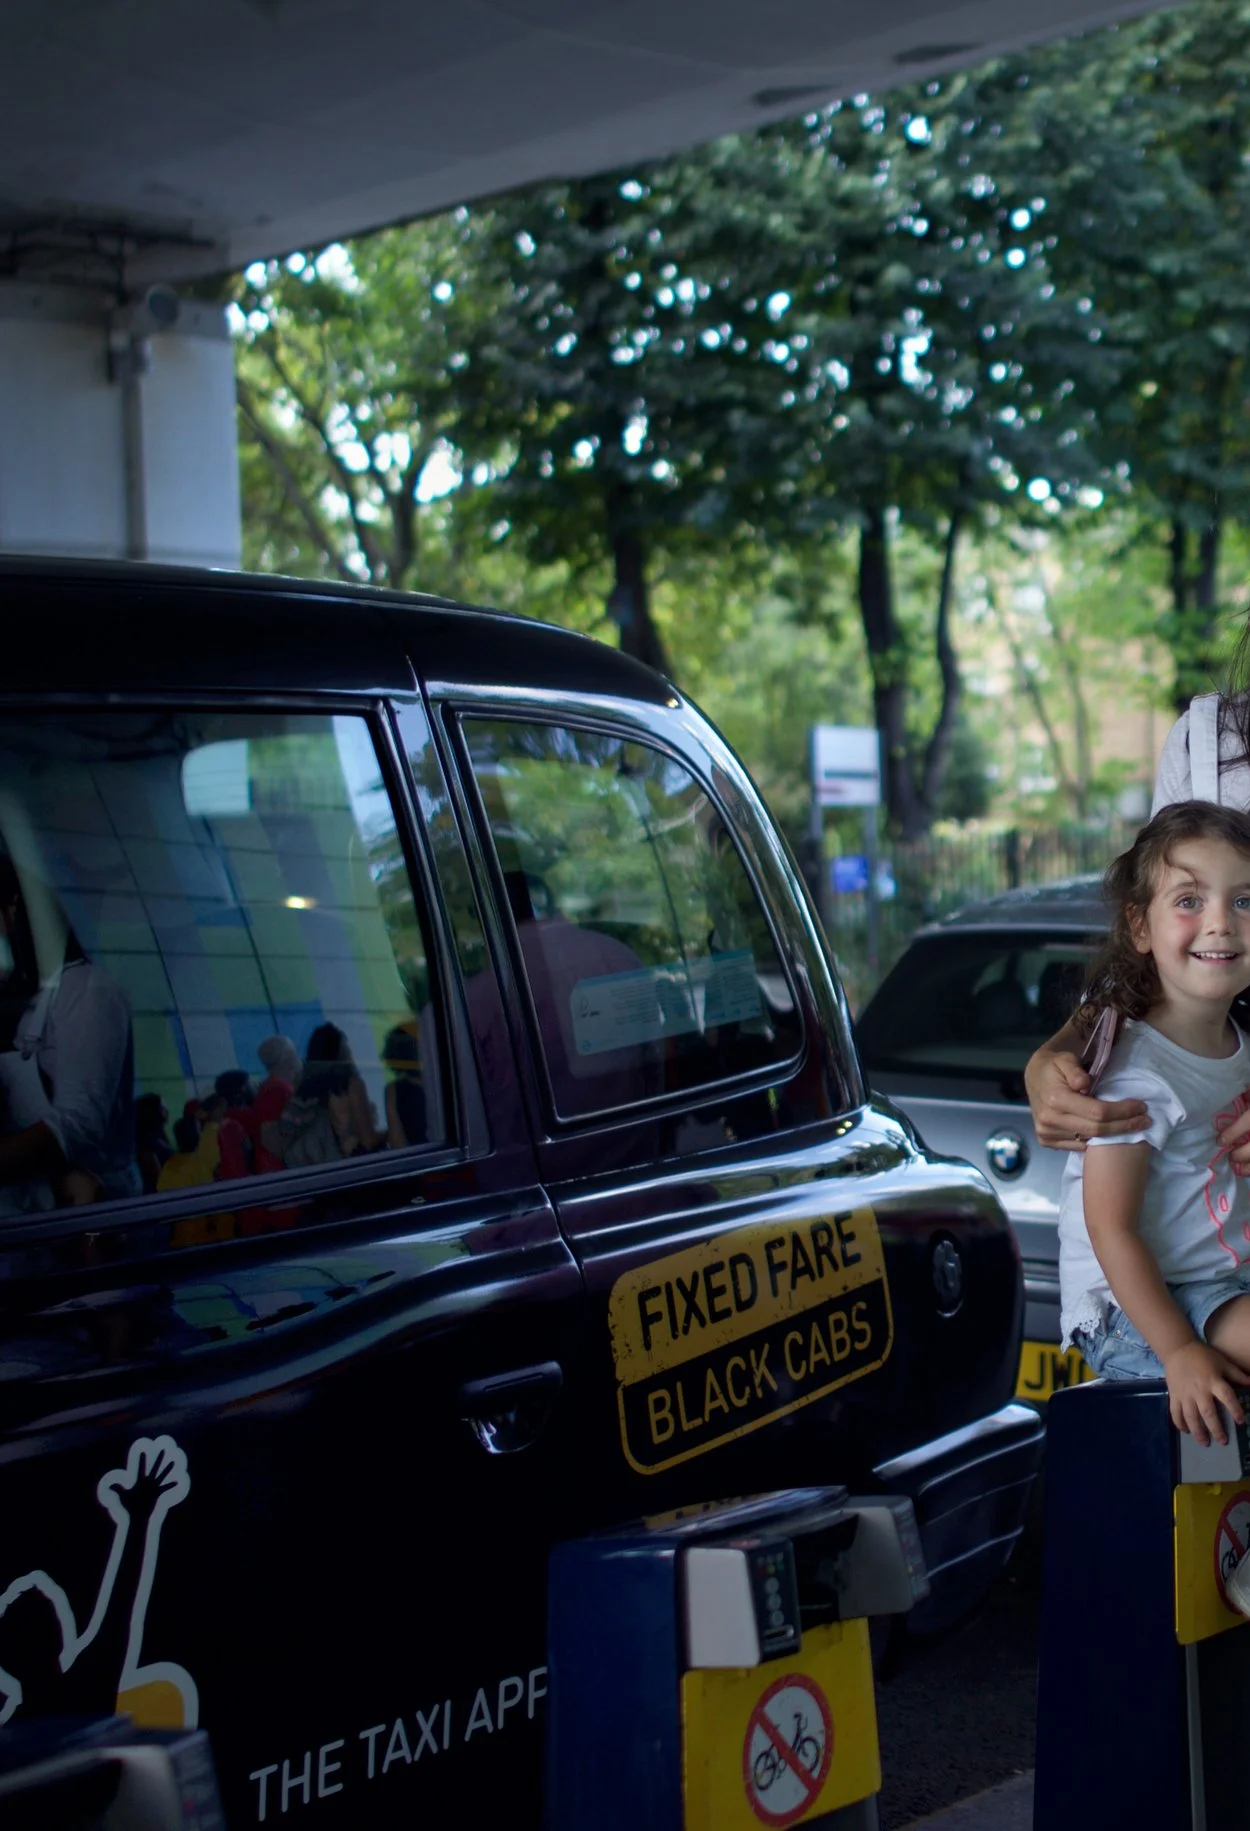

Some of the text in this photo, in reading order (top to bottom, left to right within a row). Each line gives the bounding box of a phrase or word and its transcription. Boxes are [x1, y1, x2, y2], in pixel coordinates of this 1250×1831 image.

[637, 1210, 862, 1351] FIXED FARE
[647, 1301, 873, 1445] BLACK CABS
[249, 1739, 345, 1822] THE
[359, 1699, 452, 1779] TAXI
